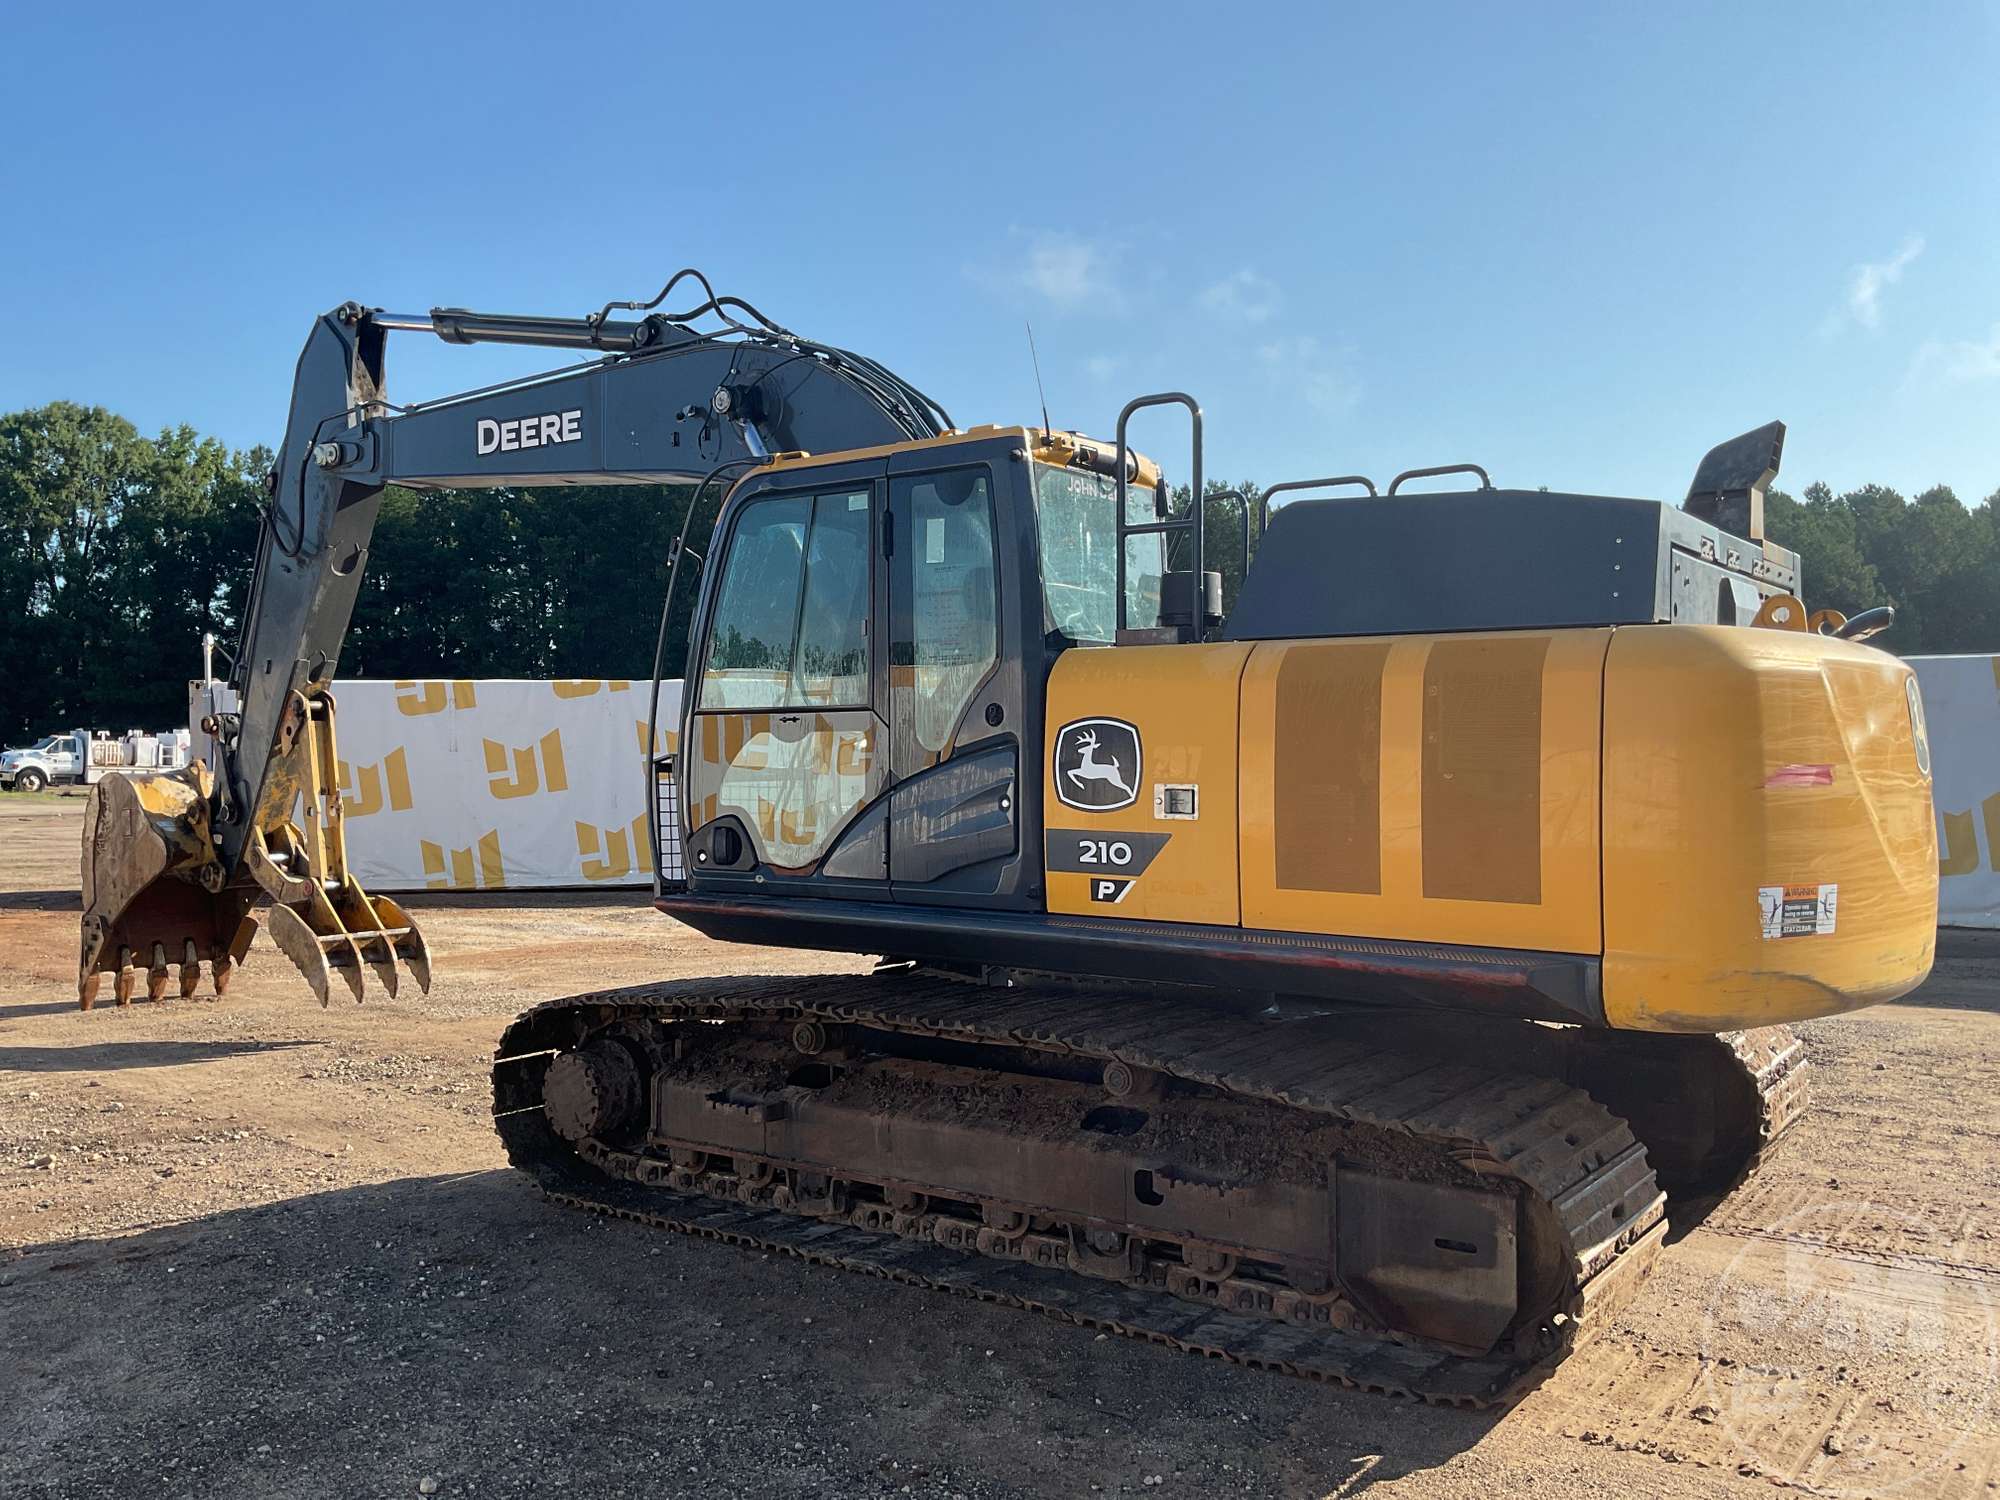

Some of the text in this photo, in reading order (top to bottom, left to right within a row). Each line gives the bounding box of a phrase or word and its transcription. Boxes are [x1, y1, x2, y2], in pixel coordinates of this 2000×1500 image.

[477, 410, 582, 455] DEERE
[1067, 476, 1098, 497] JOHN
[1080, 840, 1132, 865] 210
[1098, 881, 1115, 899] P
